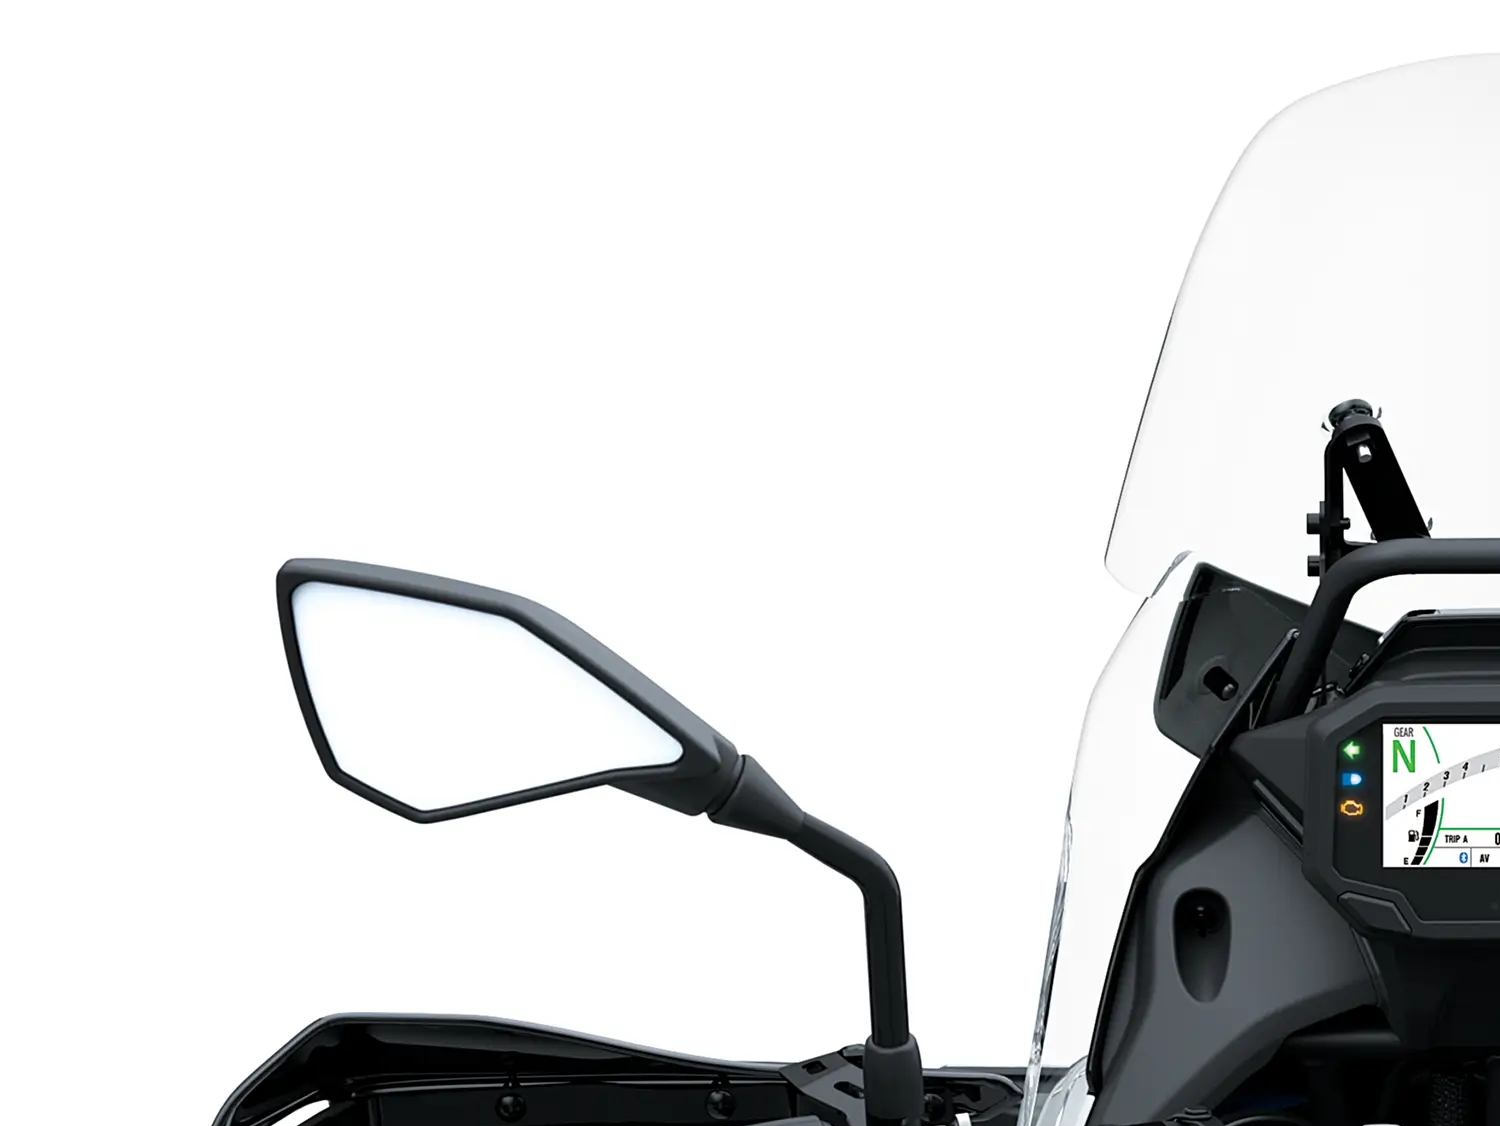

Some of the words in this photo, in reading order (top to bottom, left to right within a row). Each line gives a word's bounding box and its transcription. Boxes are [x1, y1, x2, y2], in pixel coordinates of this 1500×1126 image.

[1393, 727, 1414, 737] GEAR
[1392, 739, 1416, 773] N
[1404, 793, 1409, 803] 1
[1423, 782, 1430, 791] 2
[1443, 771, 1450, 780] 3
[1462, 762, 1469, 771] 4
[1416, 809, 1422, 818] F
[1444, 834, 1460, 844] TRIP
[1462, 834, 1468, 844] A
[1403, 857, 1409, 865] E
[1479, 853, 1490, 863] AV
